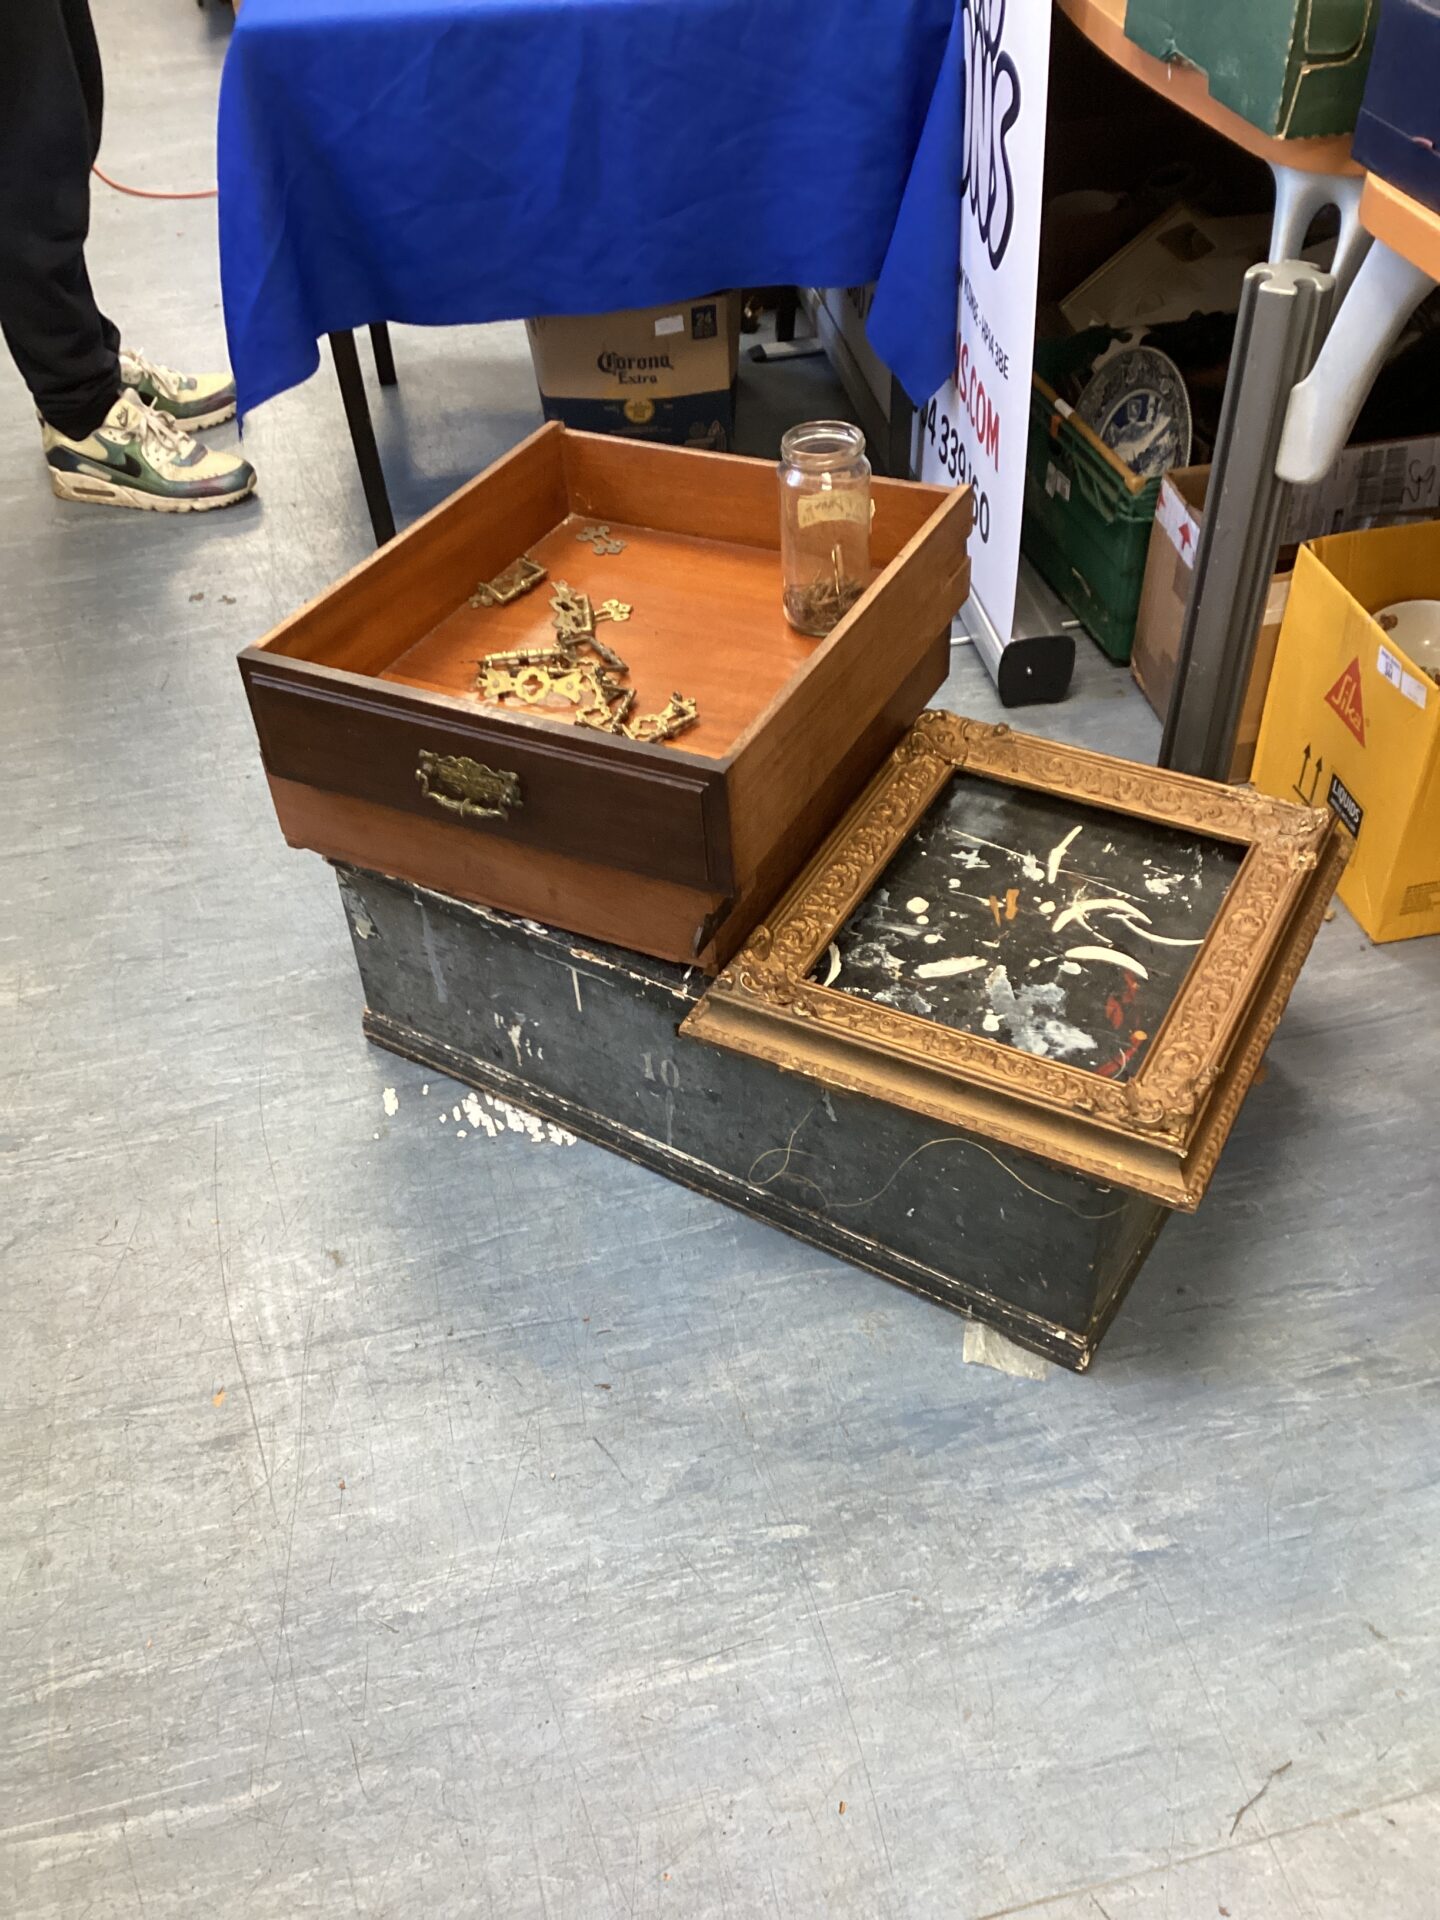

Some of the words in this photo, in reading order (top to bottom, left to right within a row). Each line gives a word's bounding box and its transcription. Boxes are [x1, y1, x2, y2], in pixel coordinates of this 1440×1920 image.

[597, 351, 674, 376] Corona
[618, 370, 658, 385] Extra
[955, 331, 1000, 473] S.COM
[1331, 674, 1361, 732] Sika
[1332, 779, 1361, 823] LIQUIDS
